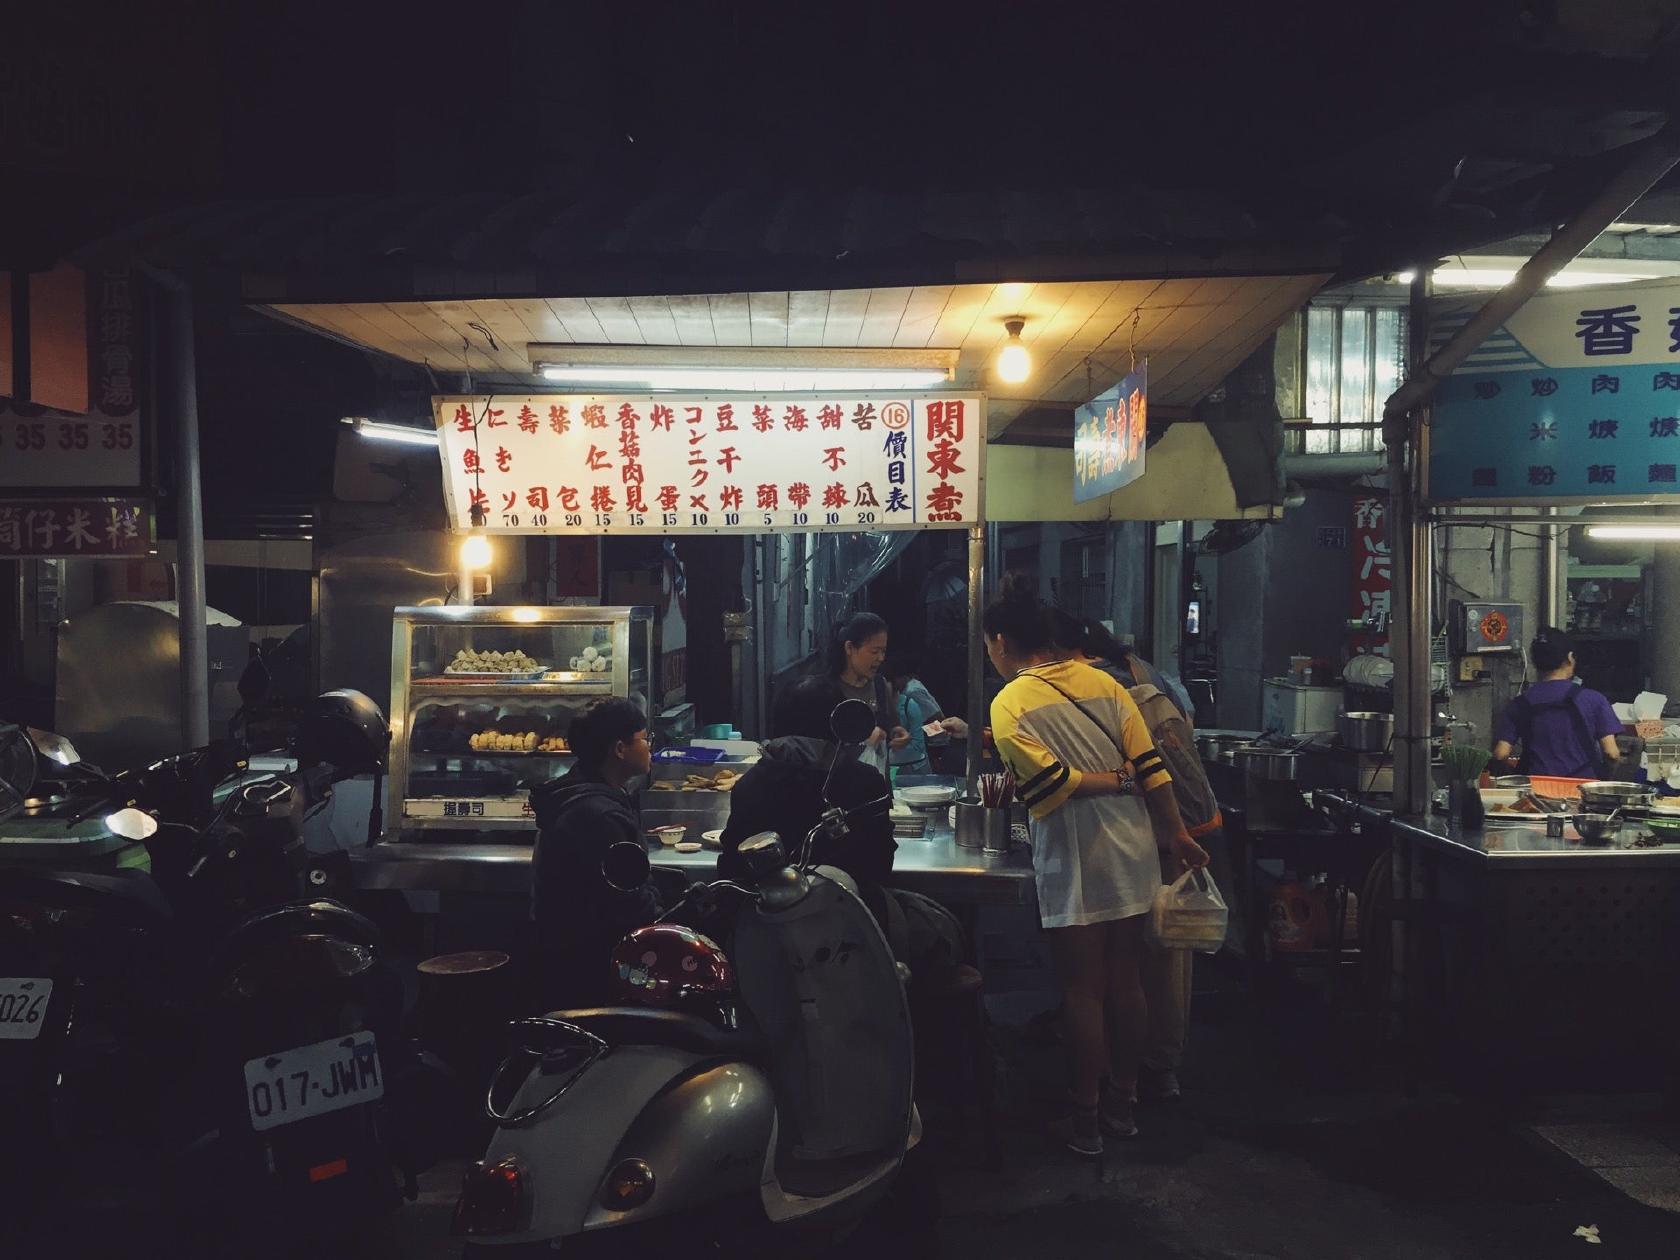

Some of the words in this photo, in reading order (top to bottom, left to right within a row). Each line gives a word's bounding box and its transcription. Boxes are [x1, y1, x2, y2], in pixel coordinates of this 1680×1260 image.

[15, 424, 45, 450] 35
[58, 424, 89, 450] 35
[101, 424, 133, 450] 35
[453, 404, 491, 515] 生魚片
[517, 405, 549, 512] 壽司
[548, 405, 580, 511] 菜包
[581, 404, 617, 512] 蝦仁捲
[650, 404, 681, 512] 炸蛋
[716, 403, 744, 511] 豆干炸
[751, 404, 779, 512] 菜頭
[783, 404, 811, 511] 海帶
[816, 403, 851, 509] 甜不辣
[851, 402, 880, 509] 苦瓜
[882, 430, 912, 513] 價目表
[503, 513, 519, 526] 70
[531, 513, 547, 526] 40
[565, 513, 582, 526] 20
[596, 513, 611, 526] 15
[630, 513, 644, 526] 15
[663, 513, 677, 526] 15
[692, 513, 708, 526] 10
[725, 513, 739, 525] 10
[764, 513, 771, 525] 5
[793, 513, 808, 525] 10
[826, 513, 839, 525] 10
[858, 513, 875, 525] 20
[0, 993, 45, 1024] 026
[253, 1054, 378, 1117] 017-JWM
